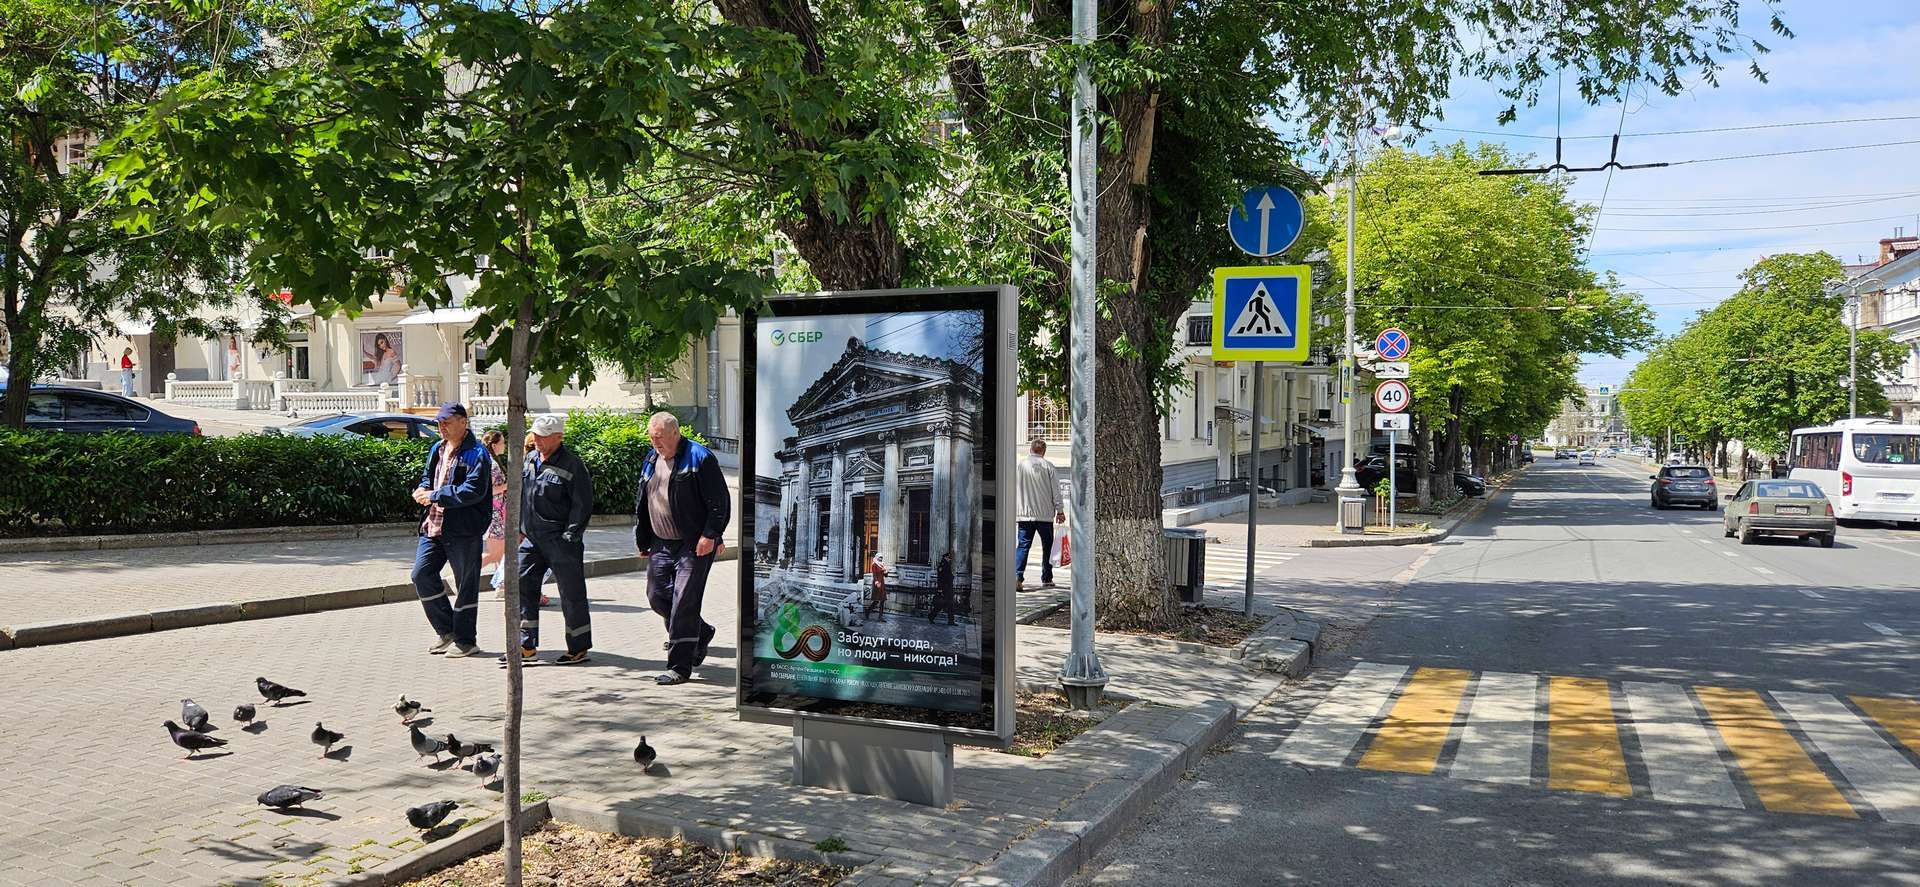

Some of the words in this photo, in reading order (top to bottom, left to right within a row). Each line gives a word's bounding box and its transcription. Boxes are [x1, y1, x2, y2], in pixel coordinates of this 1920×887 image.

[788, 331, 823, 343] СБЕР
[1382, 390, 1402, 402] 40
[837, 631, 885, 648] Забудут
[887, 639, 934, 652] города,
[837, 648, 852, 658] но
[854, 648, 887, 661] люди
[903, 653, 959, 667] никогда!
